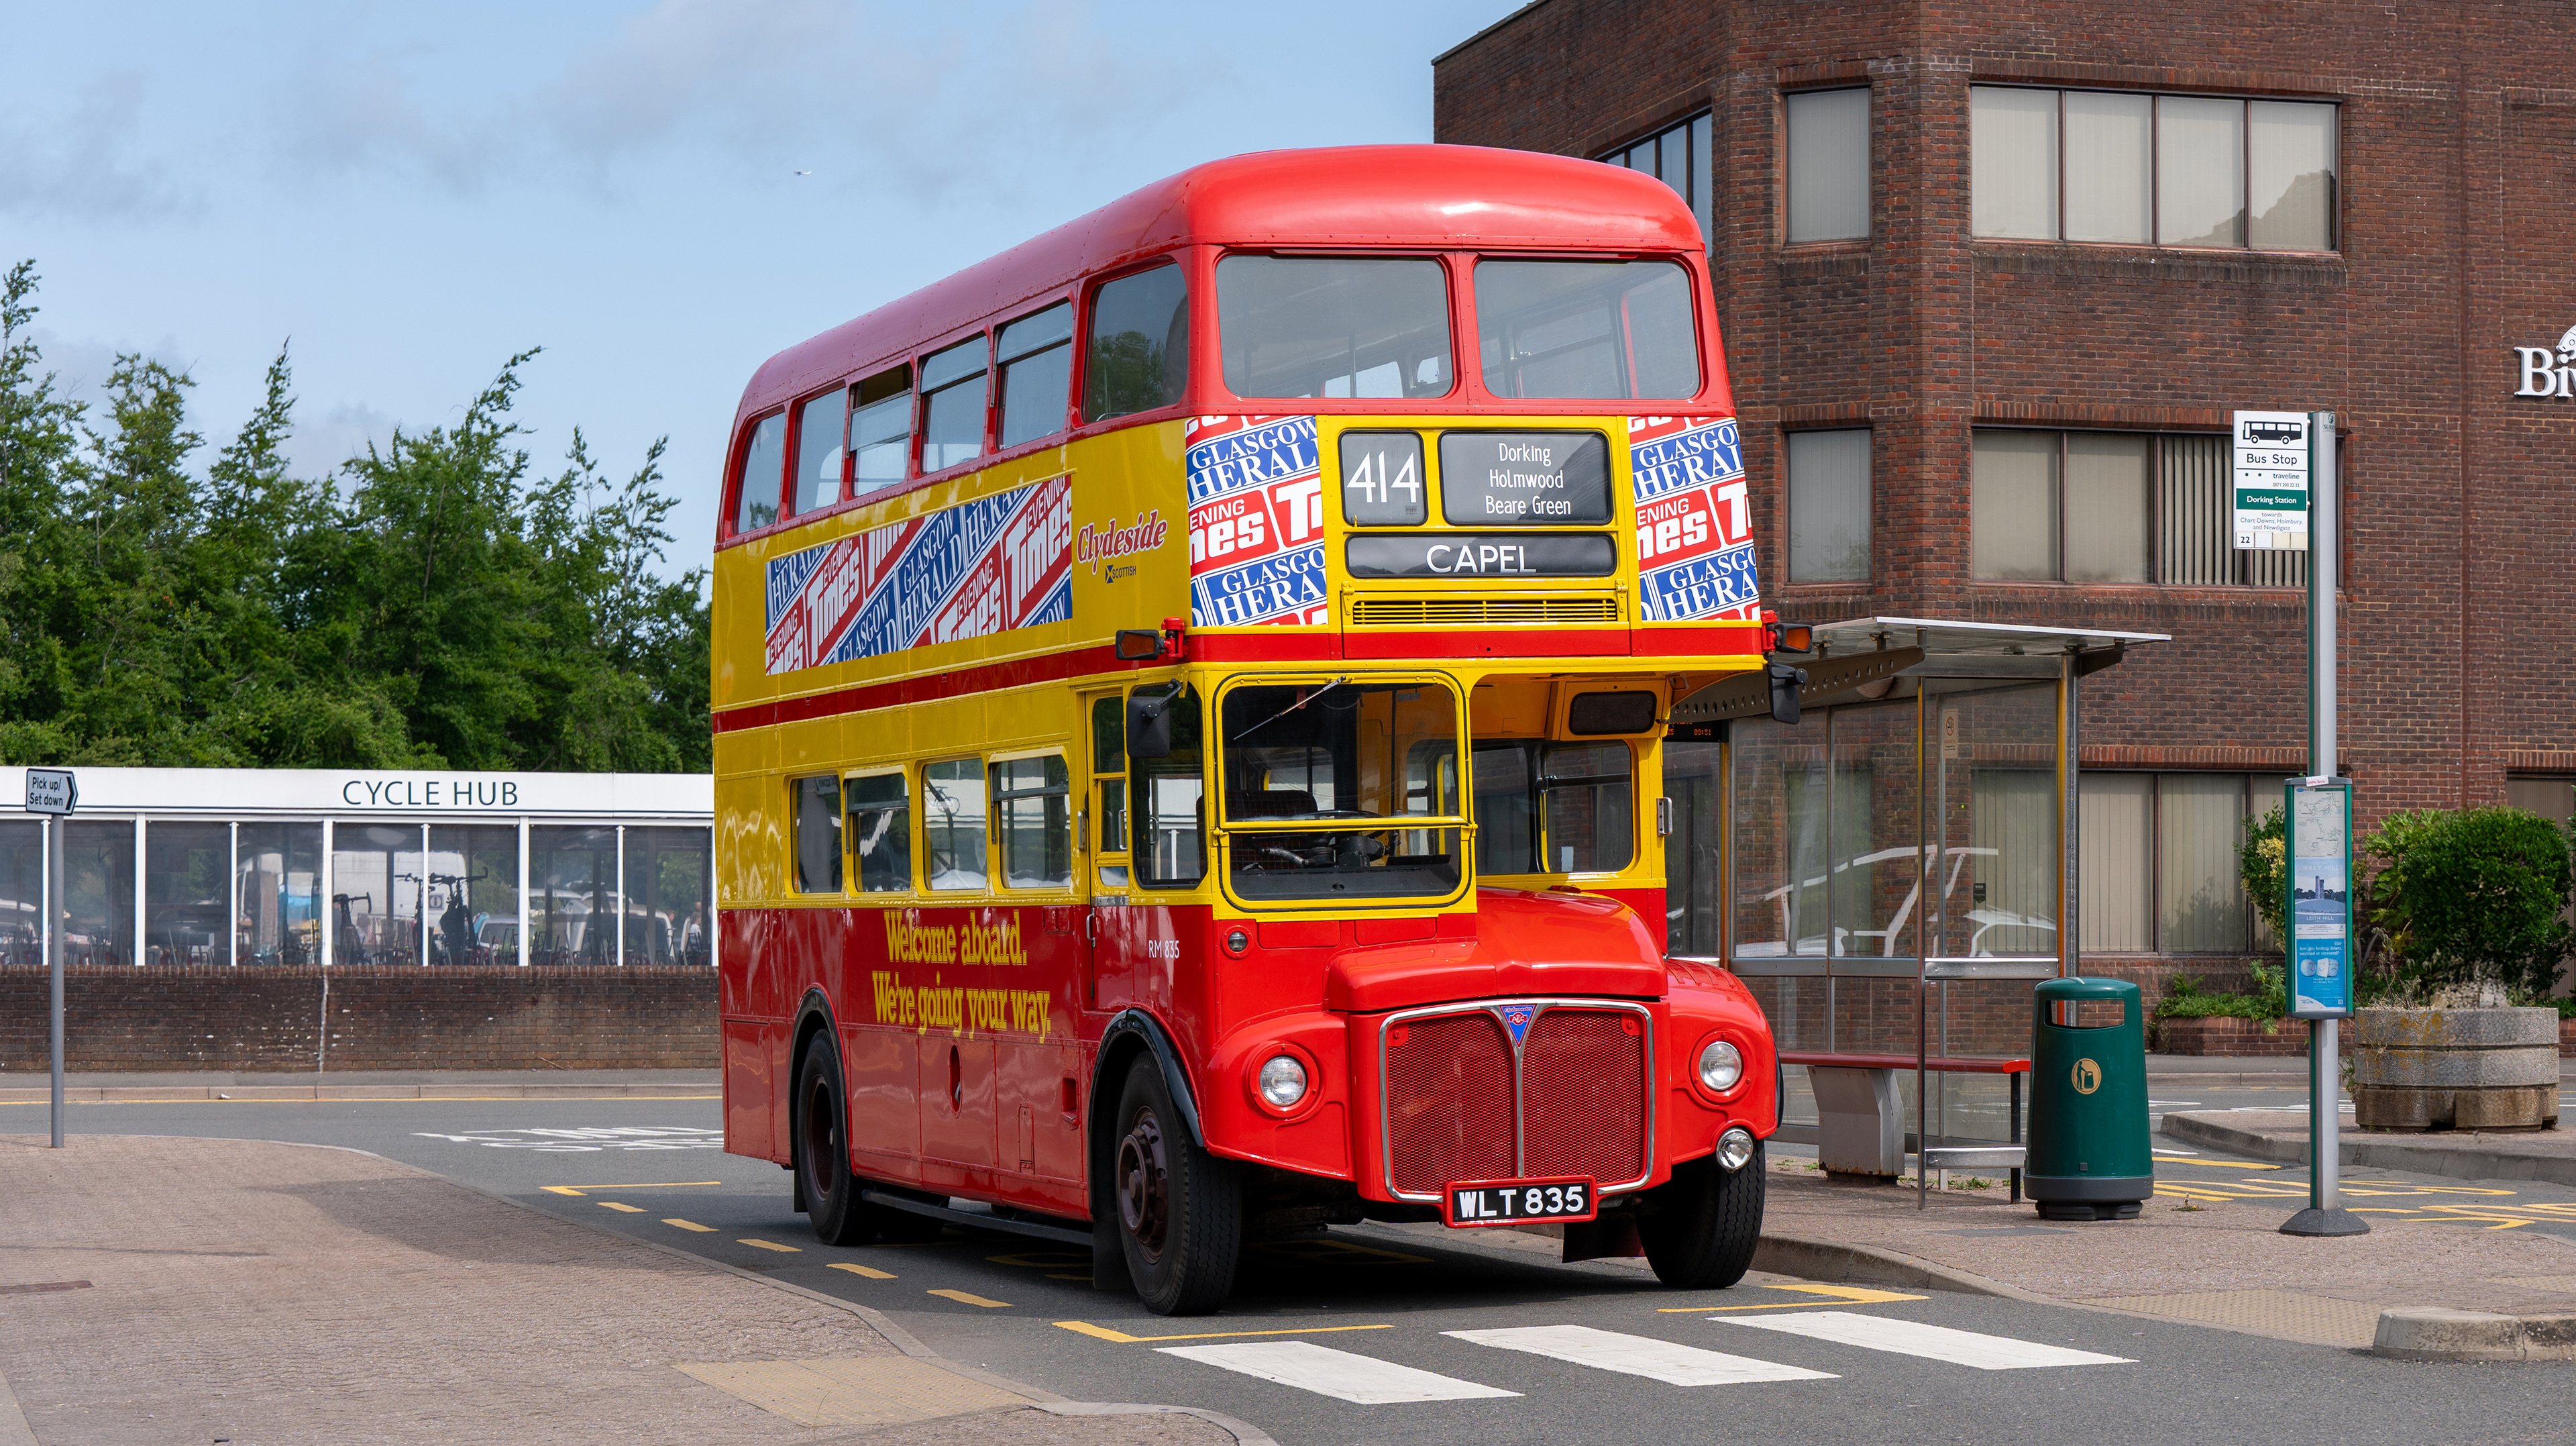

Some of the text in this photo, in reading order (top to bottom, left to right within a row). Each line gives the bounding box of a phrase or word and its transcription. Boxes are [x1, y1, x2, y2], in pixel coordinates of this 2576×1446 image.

[1187, 437, 1320, 503] HERAL
[1499, 442, 1551, 467] Dorking
[1639, 424, 1740, 468] GLASGO
[2247, 454, 2298, 466] Bus Stop
[1346, 450, 1420, 503] 414
[1489, 468, 1564, 488] Holmwood
[2247, 496, 2273, 505] Dorking
[967, 488, 1023, 560] HERA
[1027, 476, 1065, 533] EVENING
[1485, 495, 1571, 515] Beare Green
[823, 538, 853, 588] EVENING
[904, 509, 954, 594] GLASGOW
[1077, 509, 1168, 575] Clydeside
[1426, 544, 1537, 573] CAPEL
[901, 533, 962, 643] HERALD
[957, 557, 993, 621] EVENING
[1112, 565, 1136, 579] SCOTTISH
[1214, 569, 1327, 625] HERA
[807, 546, 859, 666] Times
[770, 609, 798, 663] EVENING
[30, 792, 63, 807] Set down
[32, 776, 62, 792] Pick up/
[342, 780, 518, 806] CYCLE HUB
[883, 909, 1027, 966] Welcome aboard.
[1148, 939, 1180, 959] RM 835
[872, 970, 1051, 1044] We're going your way.
[1458, 1186, 1583, 1218] WLT 835
